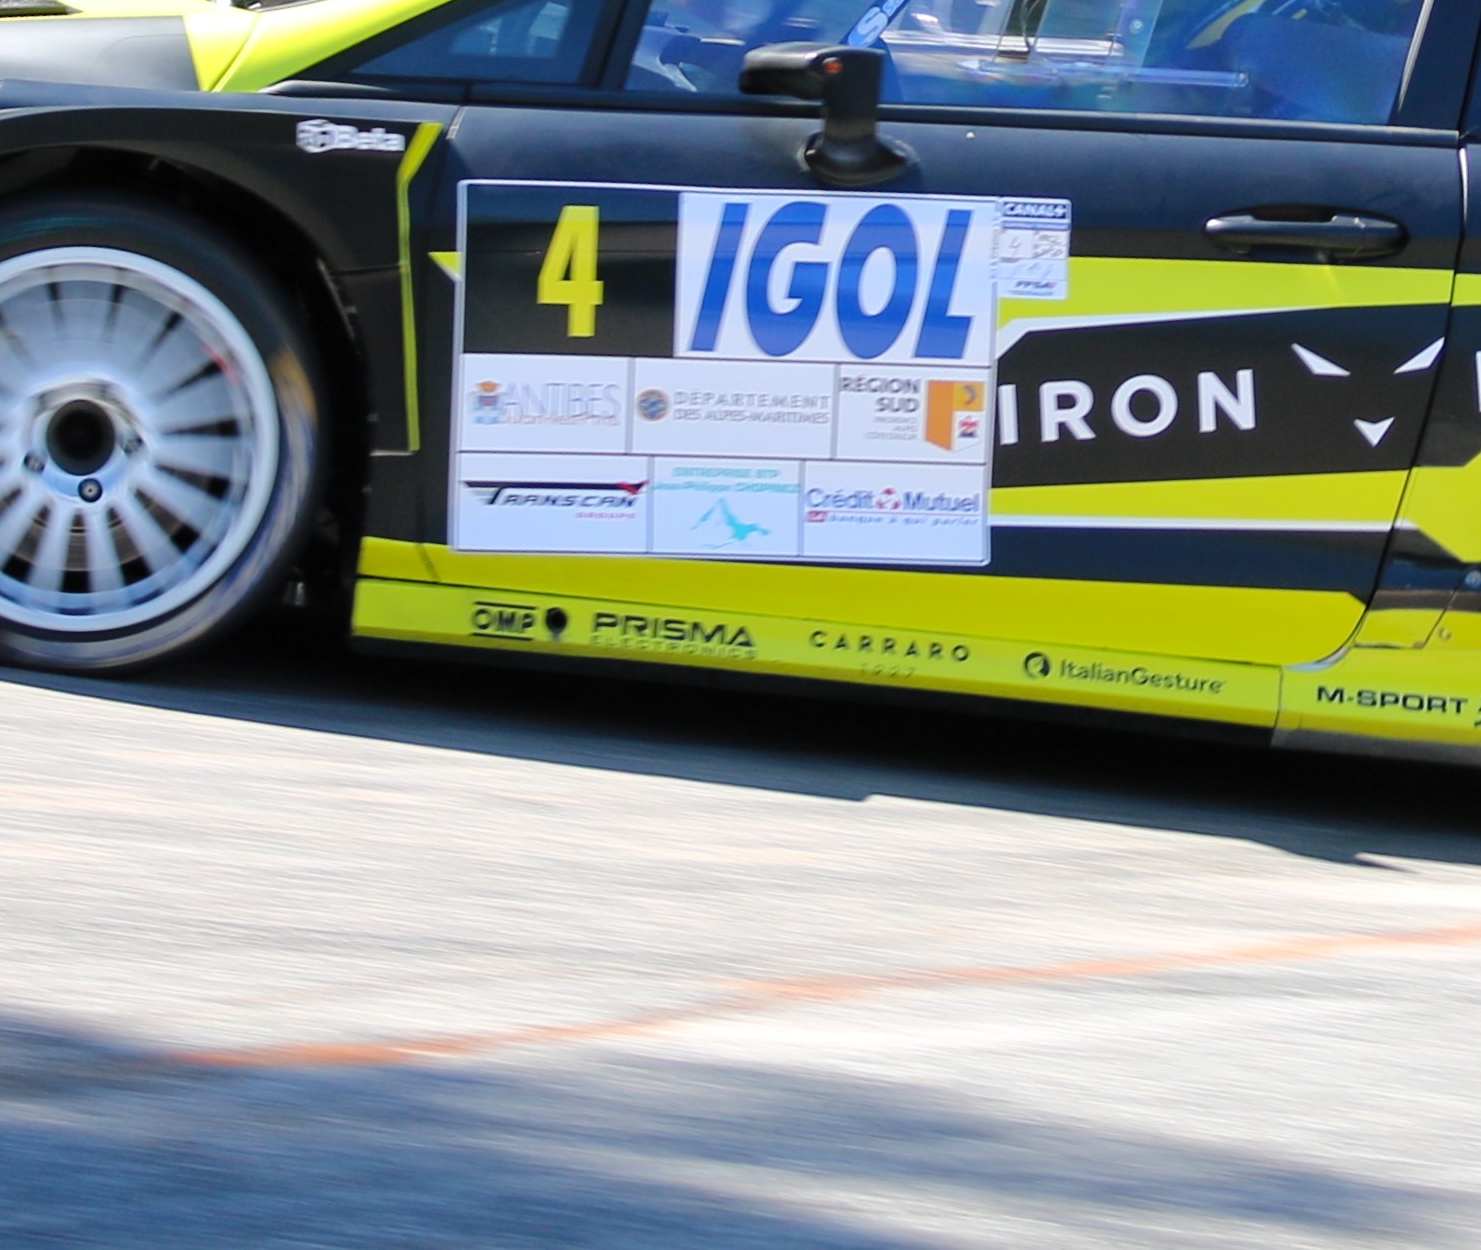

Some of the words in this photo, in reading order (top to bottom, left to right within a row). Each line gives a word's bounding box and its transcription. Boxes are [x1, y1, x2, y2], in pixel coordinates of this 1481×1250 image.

[1003, 202, 1067, 219] CANAL+
[537, 206, 603, 337] 4
[690, 201, 976, 360] IGOL
[674, 388, 831, 409] DÉPARTEMENT
[841, 375, 921, 394] RÉGION
[503, 383, 622, 418] ANTIBES
[674, 408, 702, 421] DES
[876, 397, 919, 413] SUD
[998, 368, 1256, 445] IRON
[806, 488, 875, 509] Crédit
[903, 491, 981, 512] Mutuel
[471, 605, 536, 634] OMP
[592, 612, 757, 648] PRISMA
[810, 630, 970, 663] CARRARO
[1059, 659, 1222, 694] ItalianGesture
[1317, 686, 1467, 715] M-SPORT
